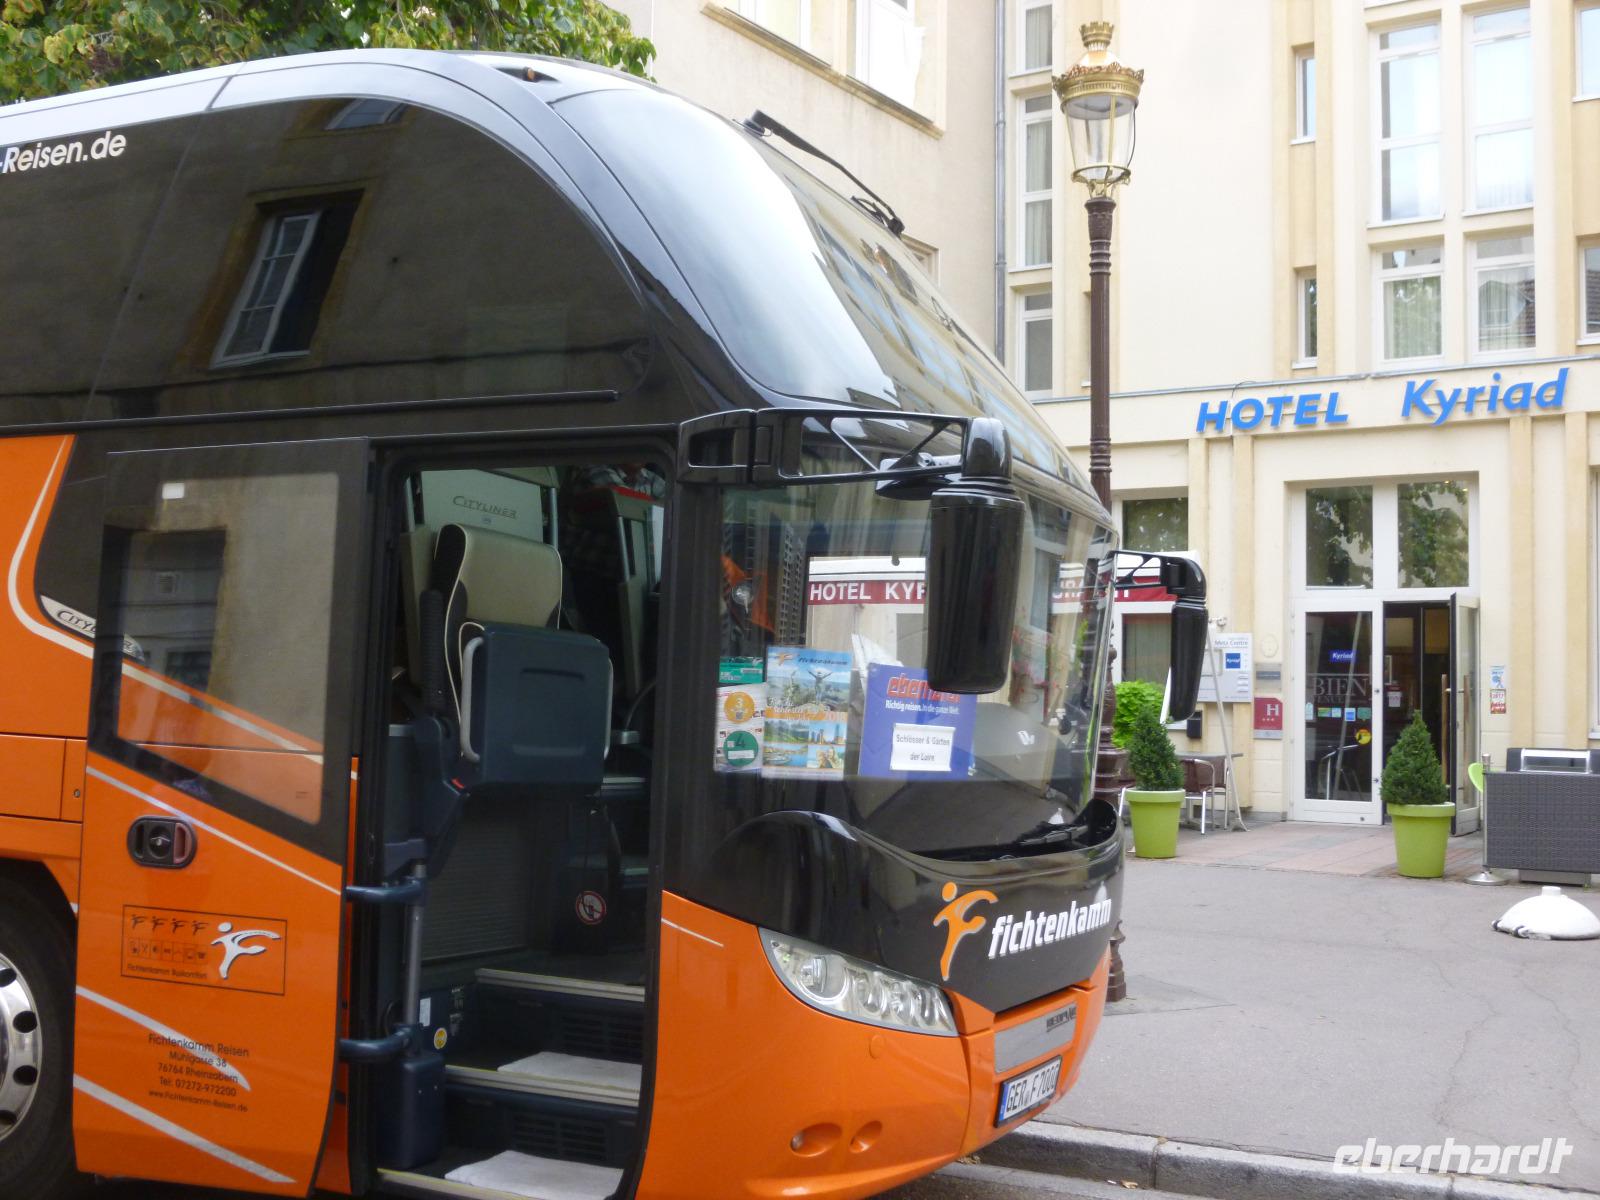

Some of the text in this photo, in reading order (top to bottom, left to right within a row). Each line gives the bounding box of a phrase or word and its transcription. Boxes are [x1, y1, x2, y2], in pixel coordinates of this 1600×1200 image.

[1196, 367, 1570, 433] HOTEL Kyriad
[453, 495, 518, 519] CITYLINER
[810, 582, 871, 601] HOTEL
[1332, 651, 1354, 660] Kyriad
[1312, 677, 1368, 696] BIEN
[1266, 703, 1279, 716] H
[987, 898, 1112, 960] fichtenkamm
[148, 1033, 249, 1057] Fichtenkamm Reisen
[1006, 1079, 1028, 1112] GER
